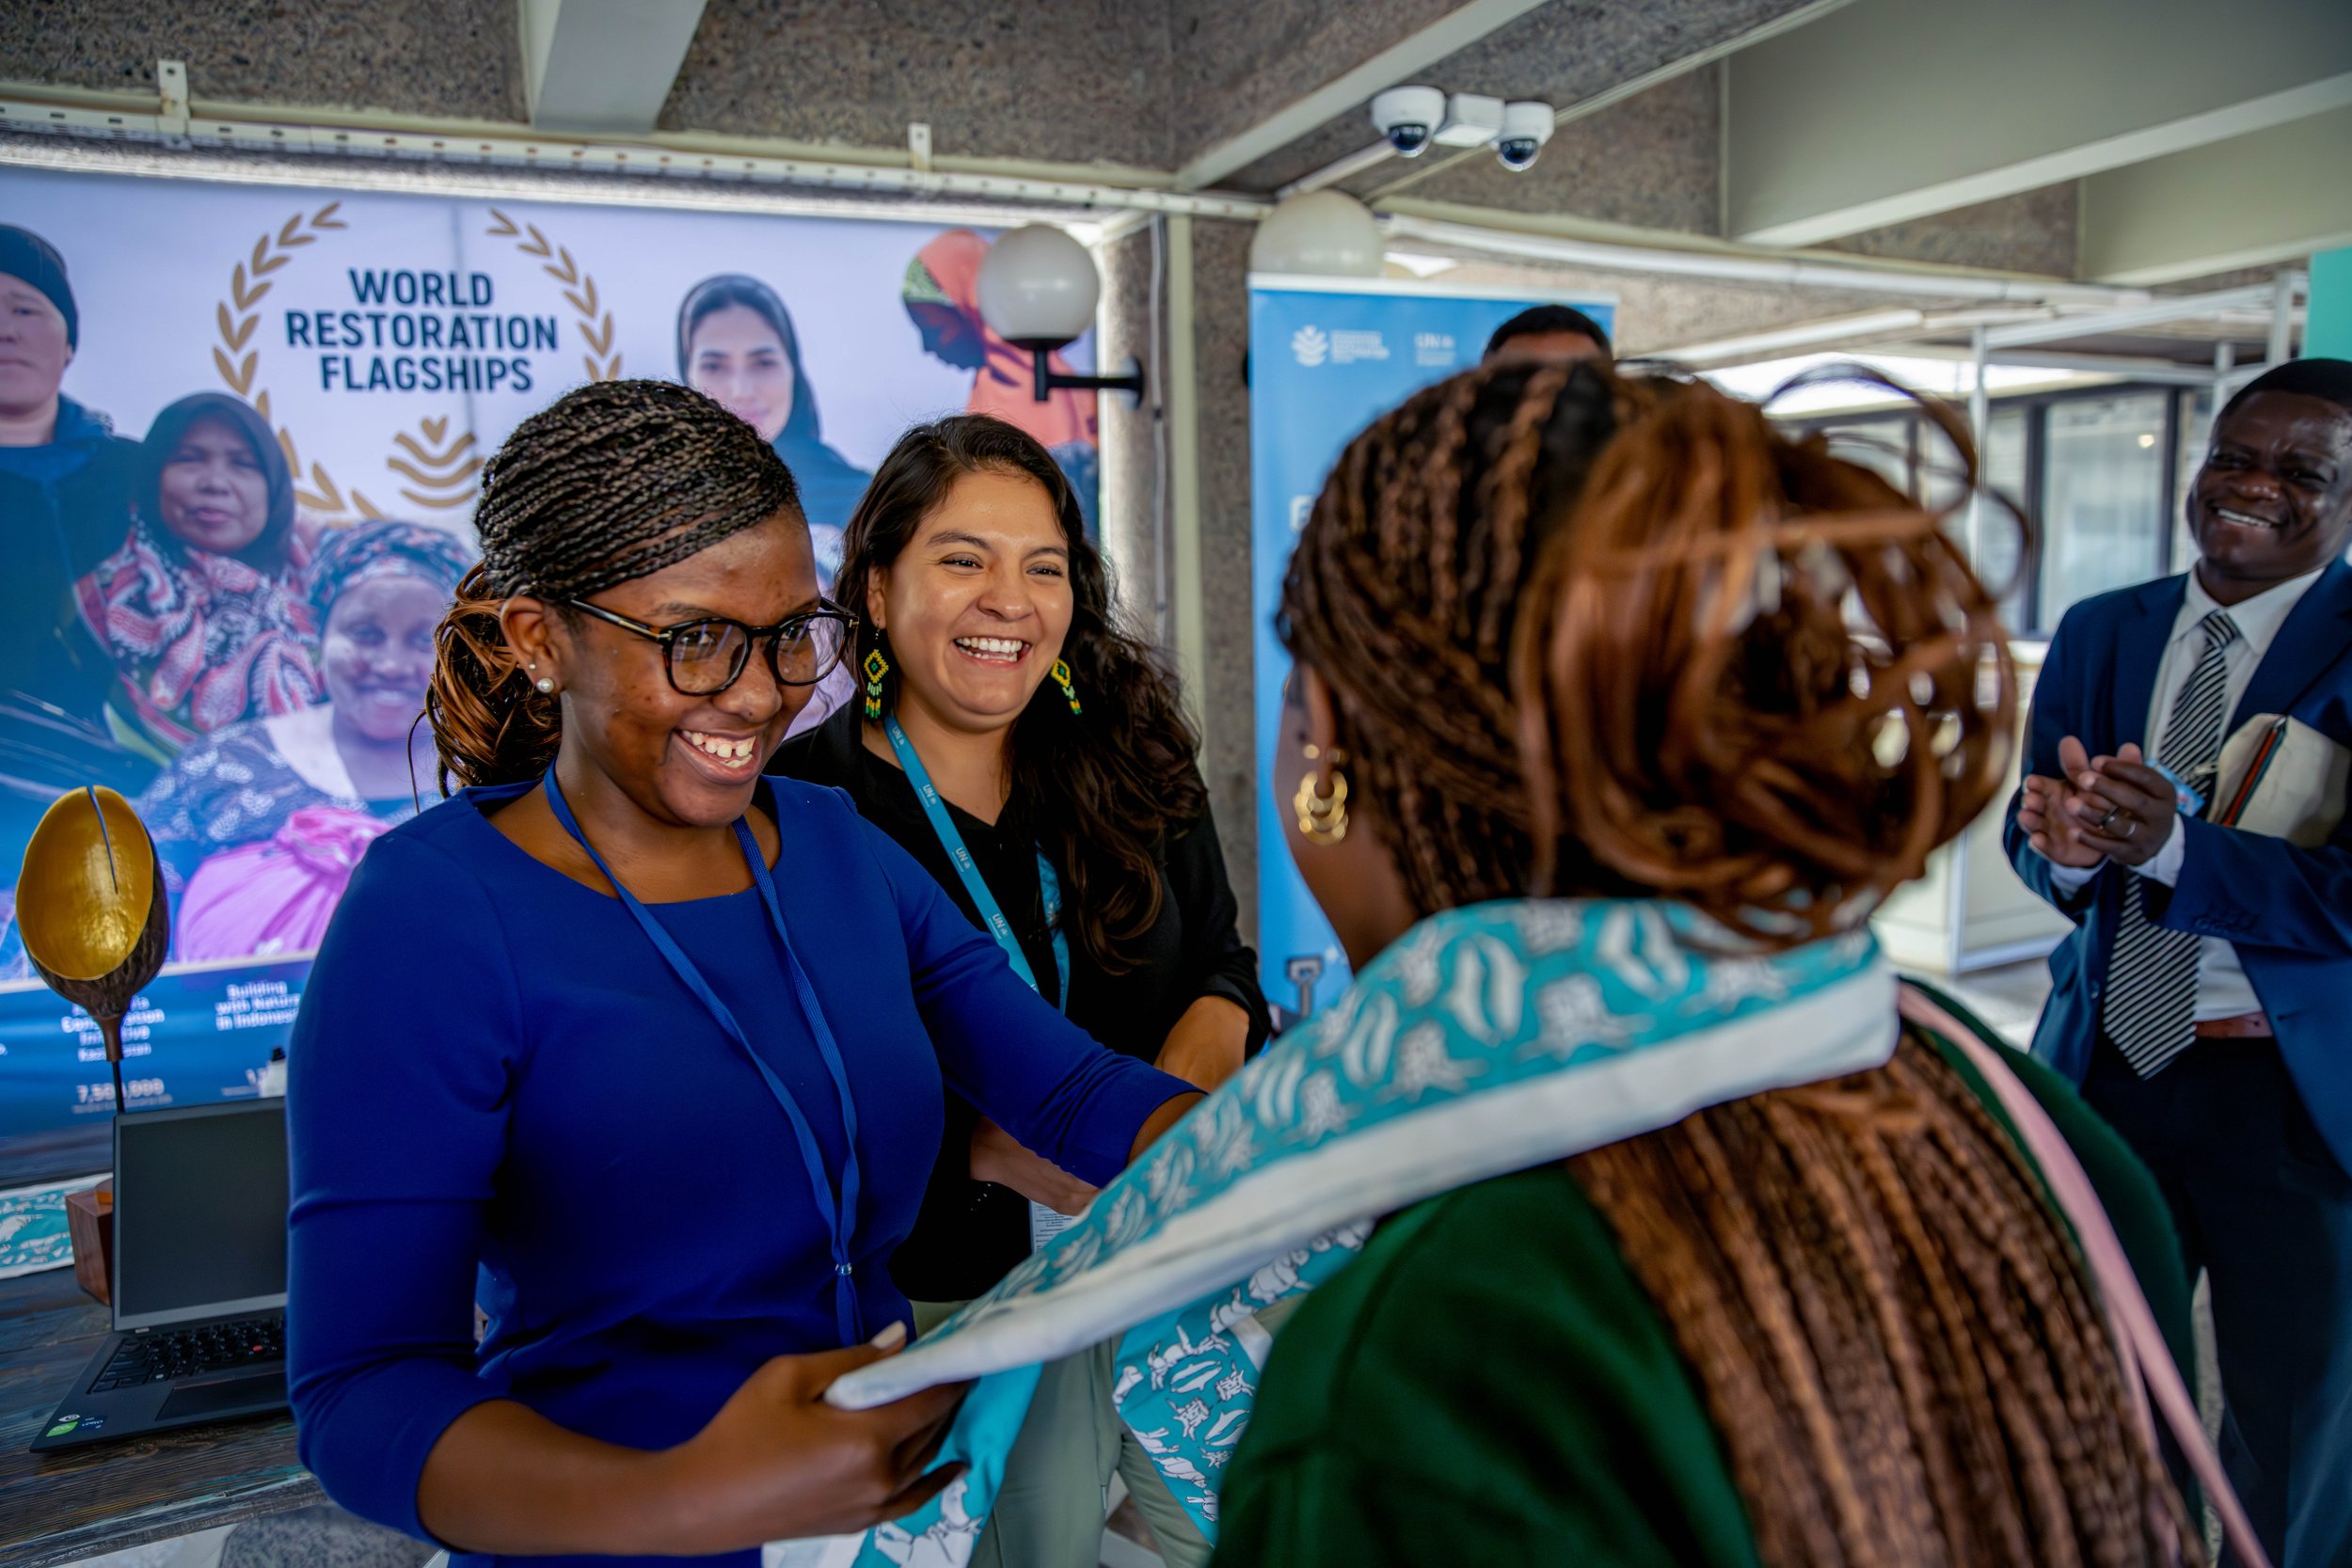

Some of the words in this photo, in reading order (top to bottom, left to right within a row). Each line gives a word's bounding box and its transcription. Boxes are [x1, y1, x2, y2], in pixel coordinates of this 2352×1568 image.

[348, 269, 494, 308] WORLD
[285, 311, 558, 350] RESTORATION
[320, 356, 532, 392] FLAGSHIPS
[892, 726, 903, 740] UN
[923, 784, 935, 798] UN
[955, 847, 969, 863] UN
[992, 912, 1006, 929] UN
[227, 980, 287, 999] Building
[215, 998, 250, 1015] with
[215, 1013, 233, 1031] in
